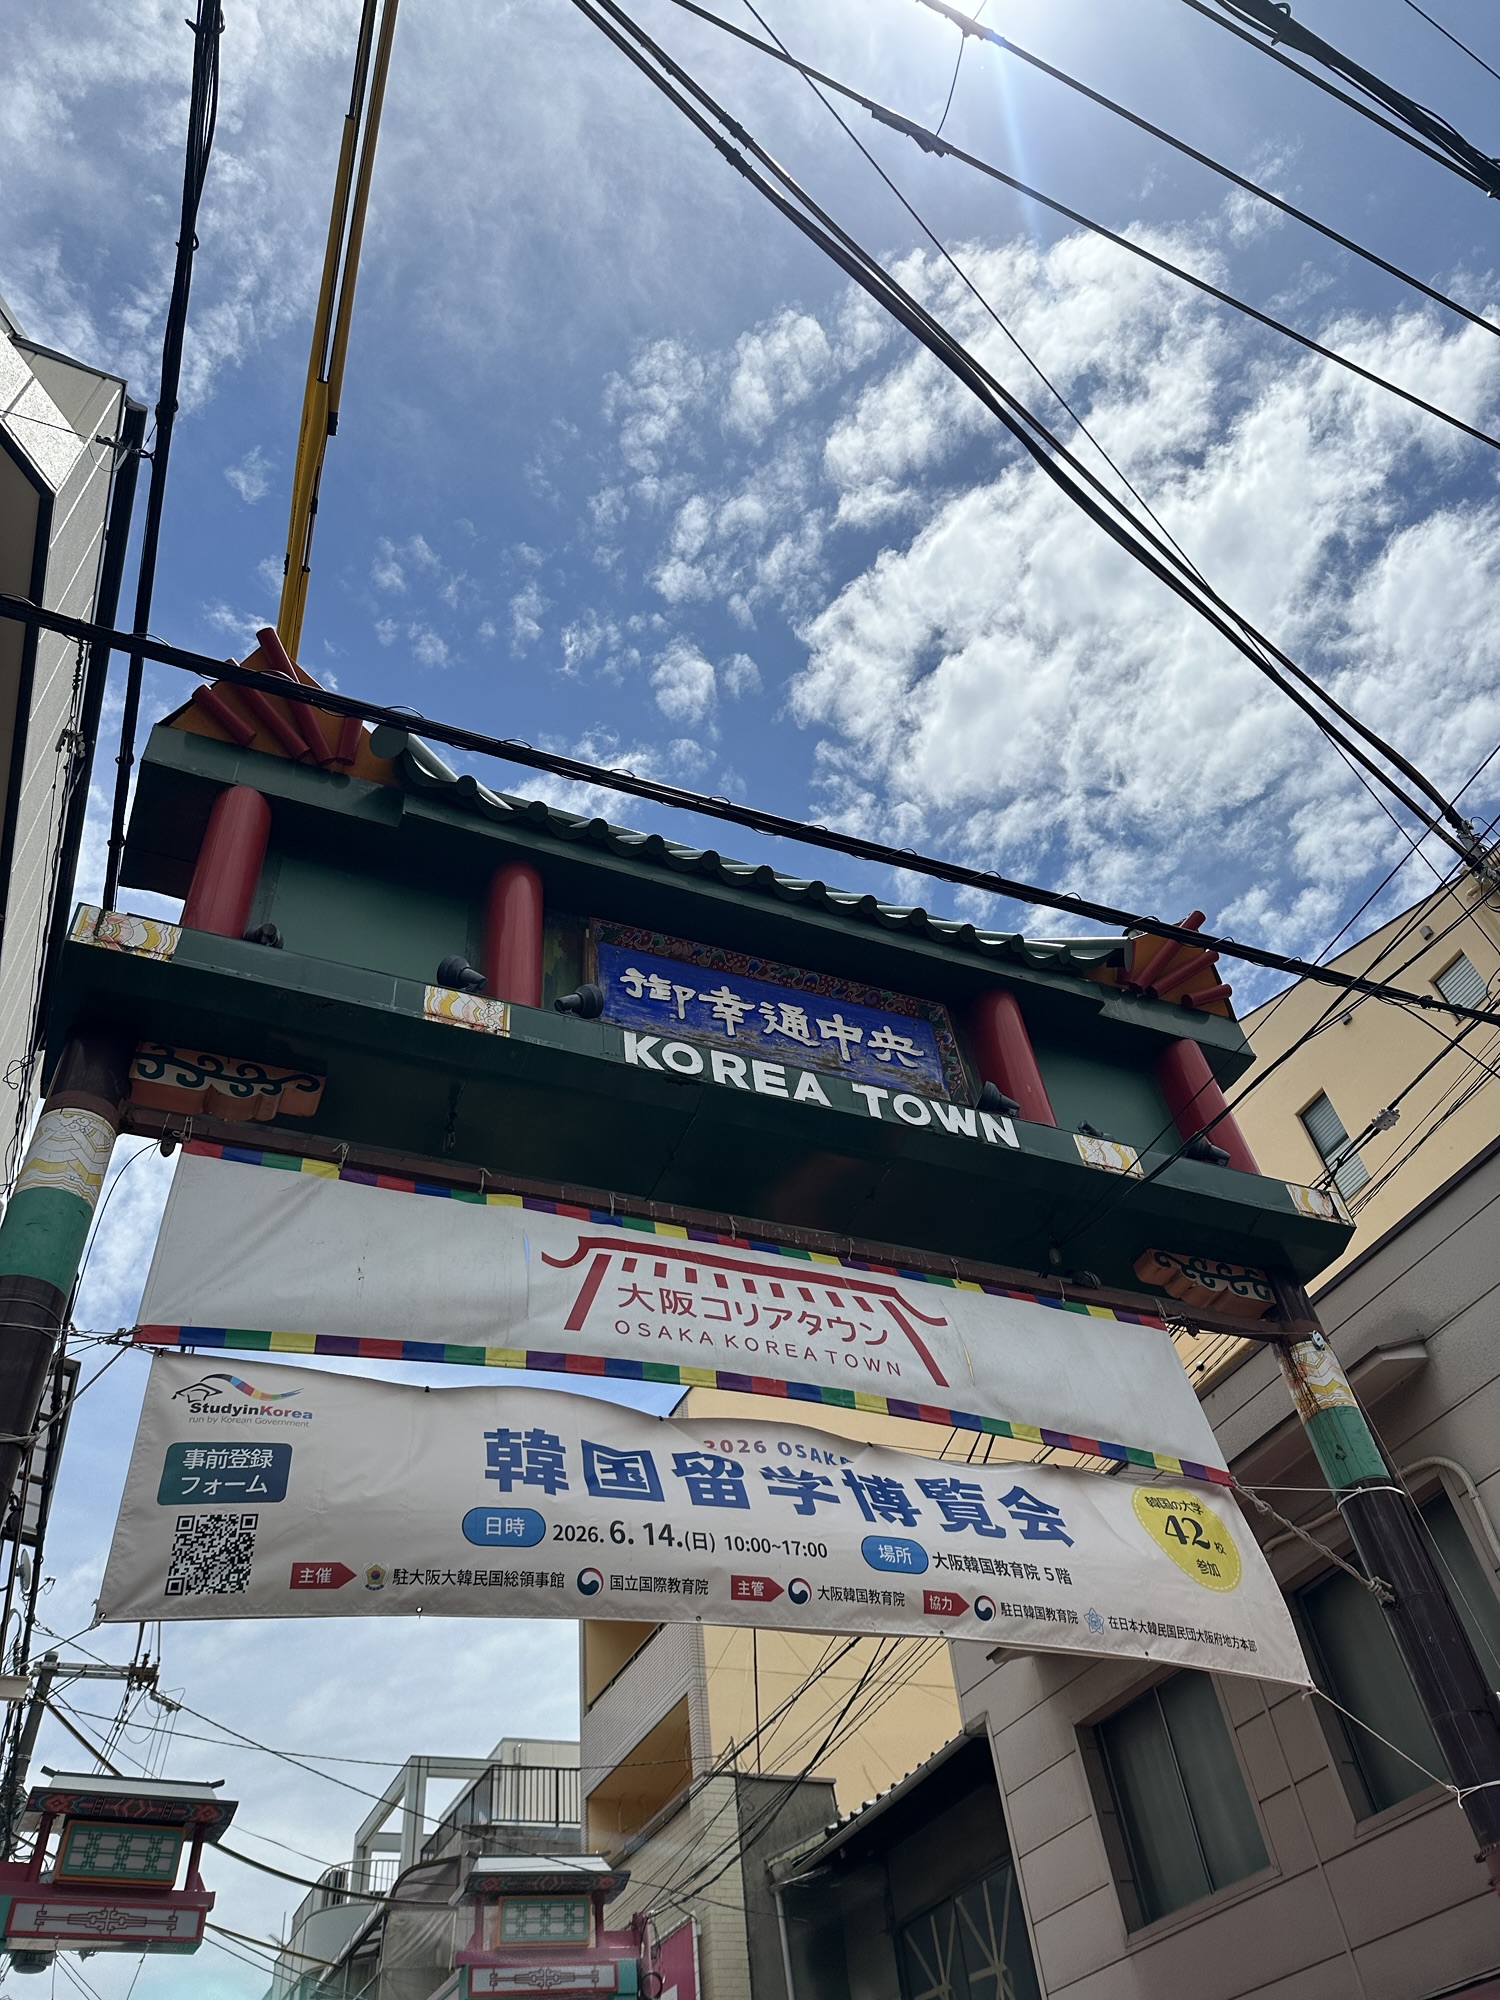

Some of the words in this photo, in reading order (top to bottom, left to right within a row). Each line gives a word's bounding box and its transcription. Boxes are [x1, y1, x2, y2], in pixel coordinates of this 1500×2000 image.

[620, 966, 925, 1068] 御幸通中央
[623, 1031, 833, 1107] KOREA
[852, 1083, 1021, 1149] TOWN
[617, 1282, 888, 1346] 大阪コリアタウン
[614, 1319, 715, 1346] OSAKA
[724, 1334, 818, 1362] KOREA
[824, 1350, 901, 1377] TOWN
[188, 1416, 205, 1424] run
[207, 1415, 219, 1425] by
[221, 1416, 252, 1424] Korean
[254, 1417, 309, 1428] Government
[189, 1402, 313, 1420] StudyinKorea
[703, 1439, 767, 1454] 2026
[182, 1448, 273, 1470] 事前登録
[181, 1474, 268, 1496] フォーム
[483, 1427, 1075, 1548] 韓国留学博覧会
[1144, 1496, 1203, 1515] 韓国の大学
[485, 1516, 525, 1538] 日時
[724, 1534, 828, 1558] 10:00~17:00
[878, 1544, 912, 1565] 場所
[298, 1567, 332, 1585] 主催
[392, 1568, 566, 1589] 駐大阪大韓民国総領事館
[1196, 1558, 1221, 1577] 参加
[610, 1574, 710, 1596] 国立国際教育院
[737, 1580, 764, 1597] 主管
[817, 1584, 906, 1607] 大阪韓国教育院
[929, 1594, 953, 1612] 協力
[1001, 1602, 1079, 1625] 駐日韓国教育院
[1107, 1616, 1258, 1653] 在日本大韓民国民団大阪府地方本部
